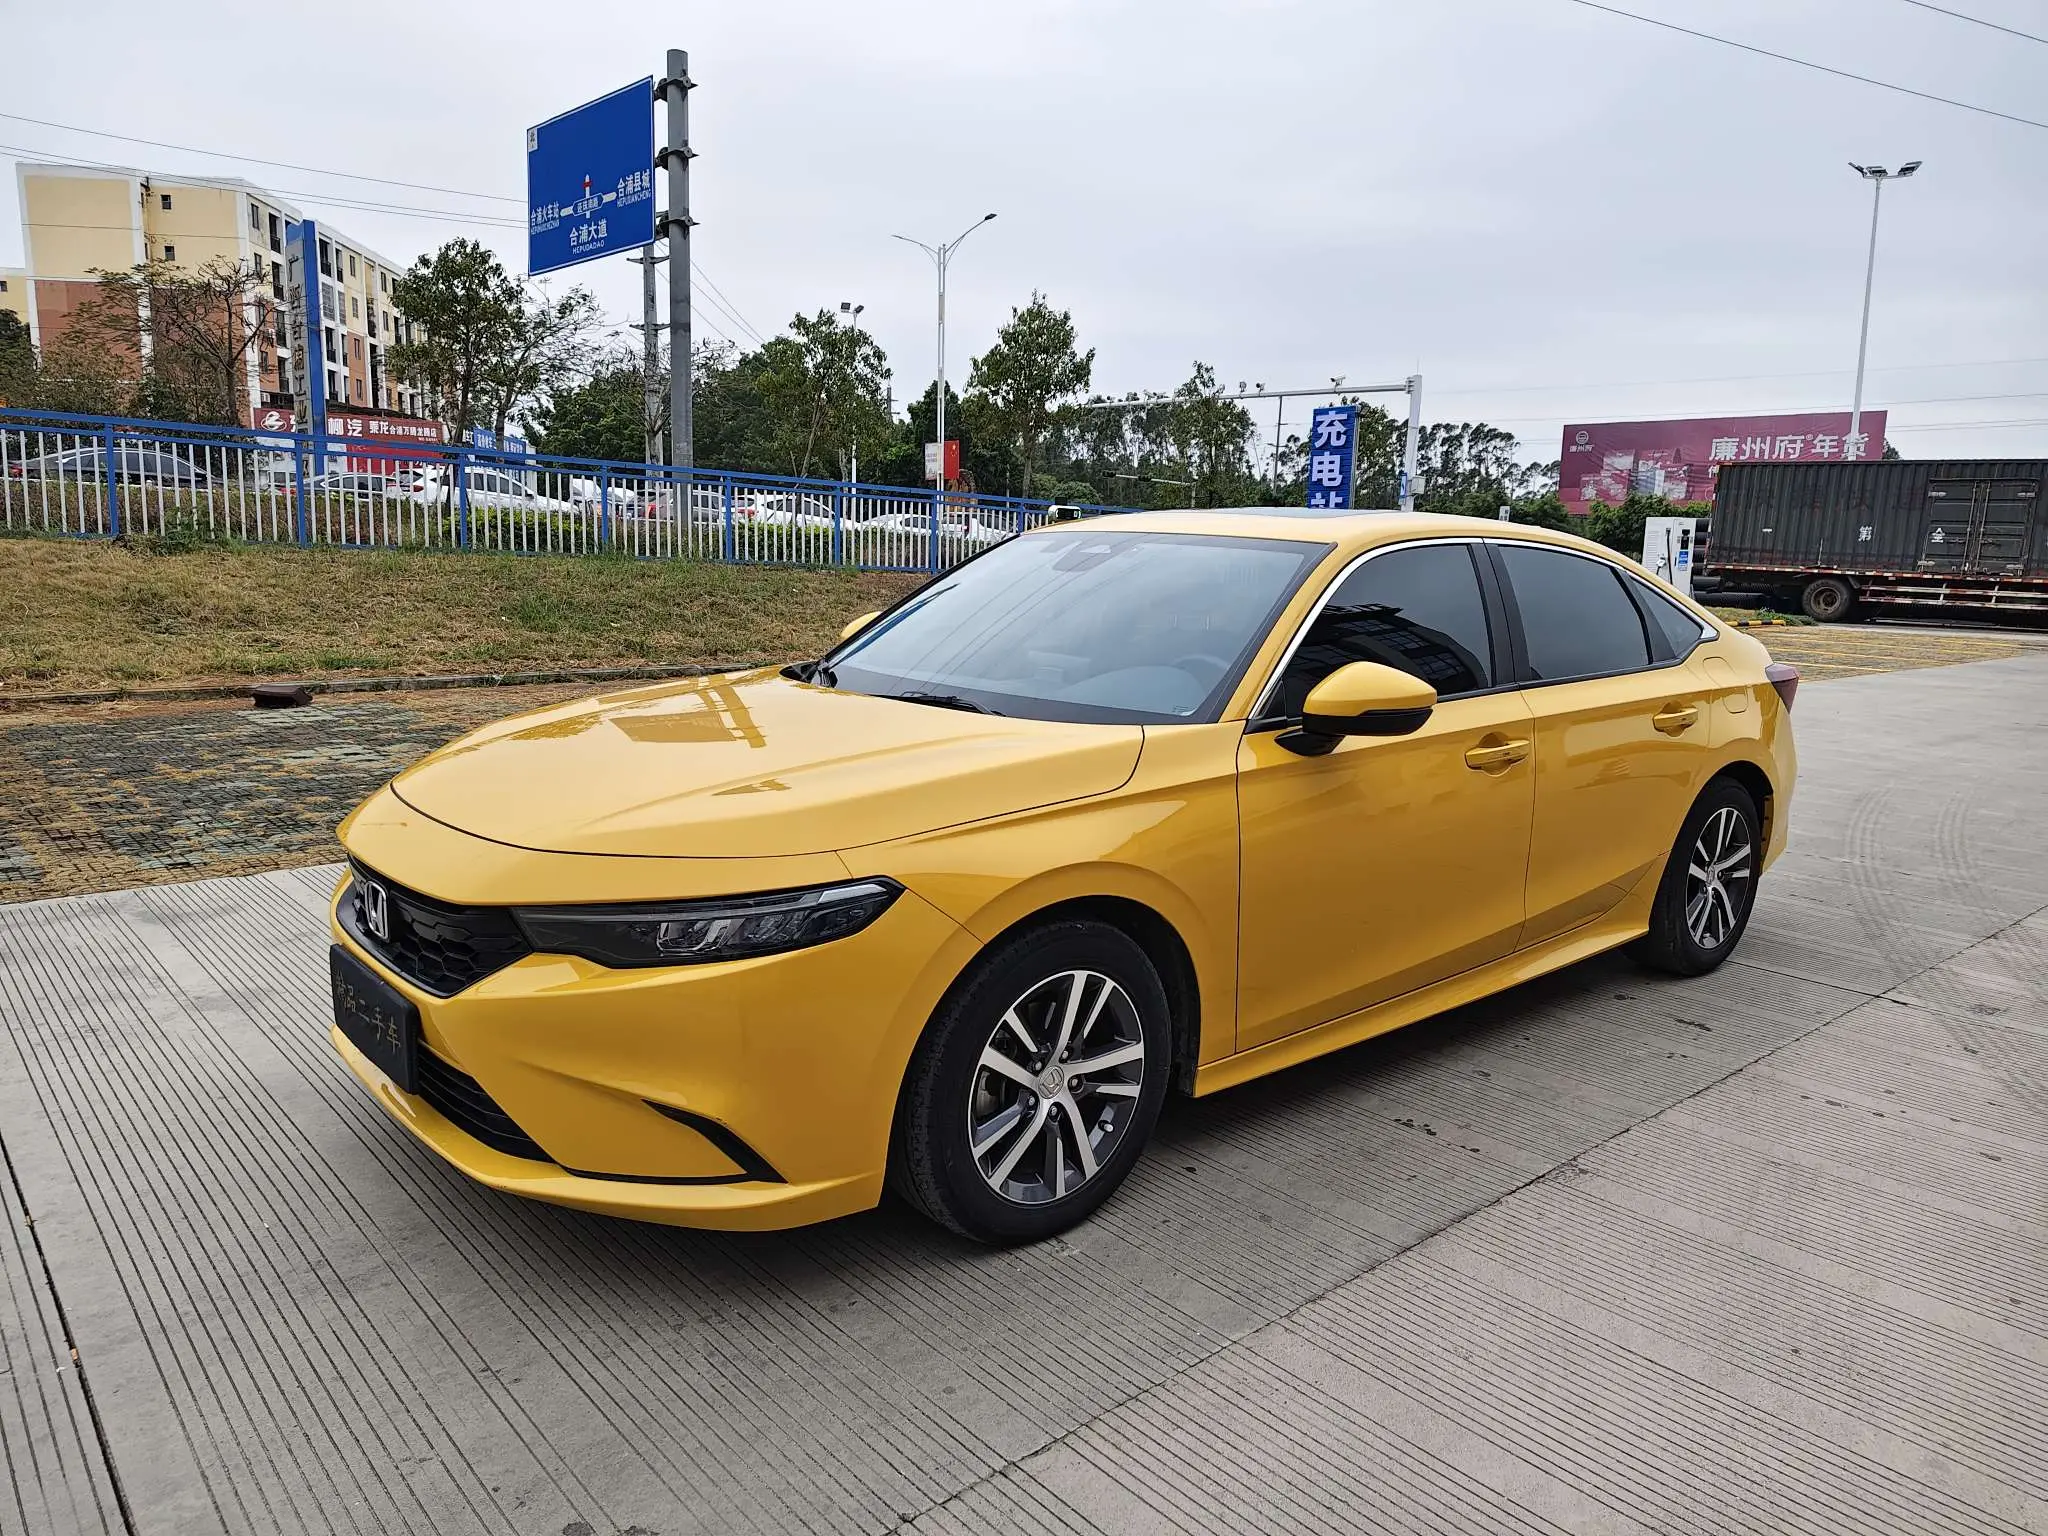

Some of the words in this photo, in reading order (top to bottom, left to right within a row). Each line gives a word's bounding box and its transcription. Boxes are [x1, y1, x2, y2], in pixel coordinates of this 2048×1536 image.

[617, 168, 651, 197] 合浦县城
[531, 200, 560, 226] 合浦火车站
[569, 218, 607, 246] 合浦大道
[572, 240, 605, 254] HEPUDADAO
[1930, 527, 1946, 543] 全
